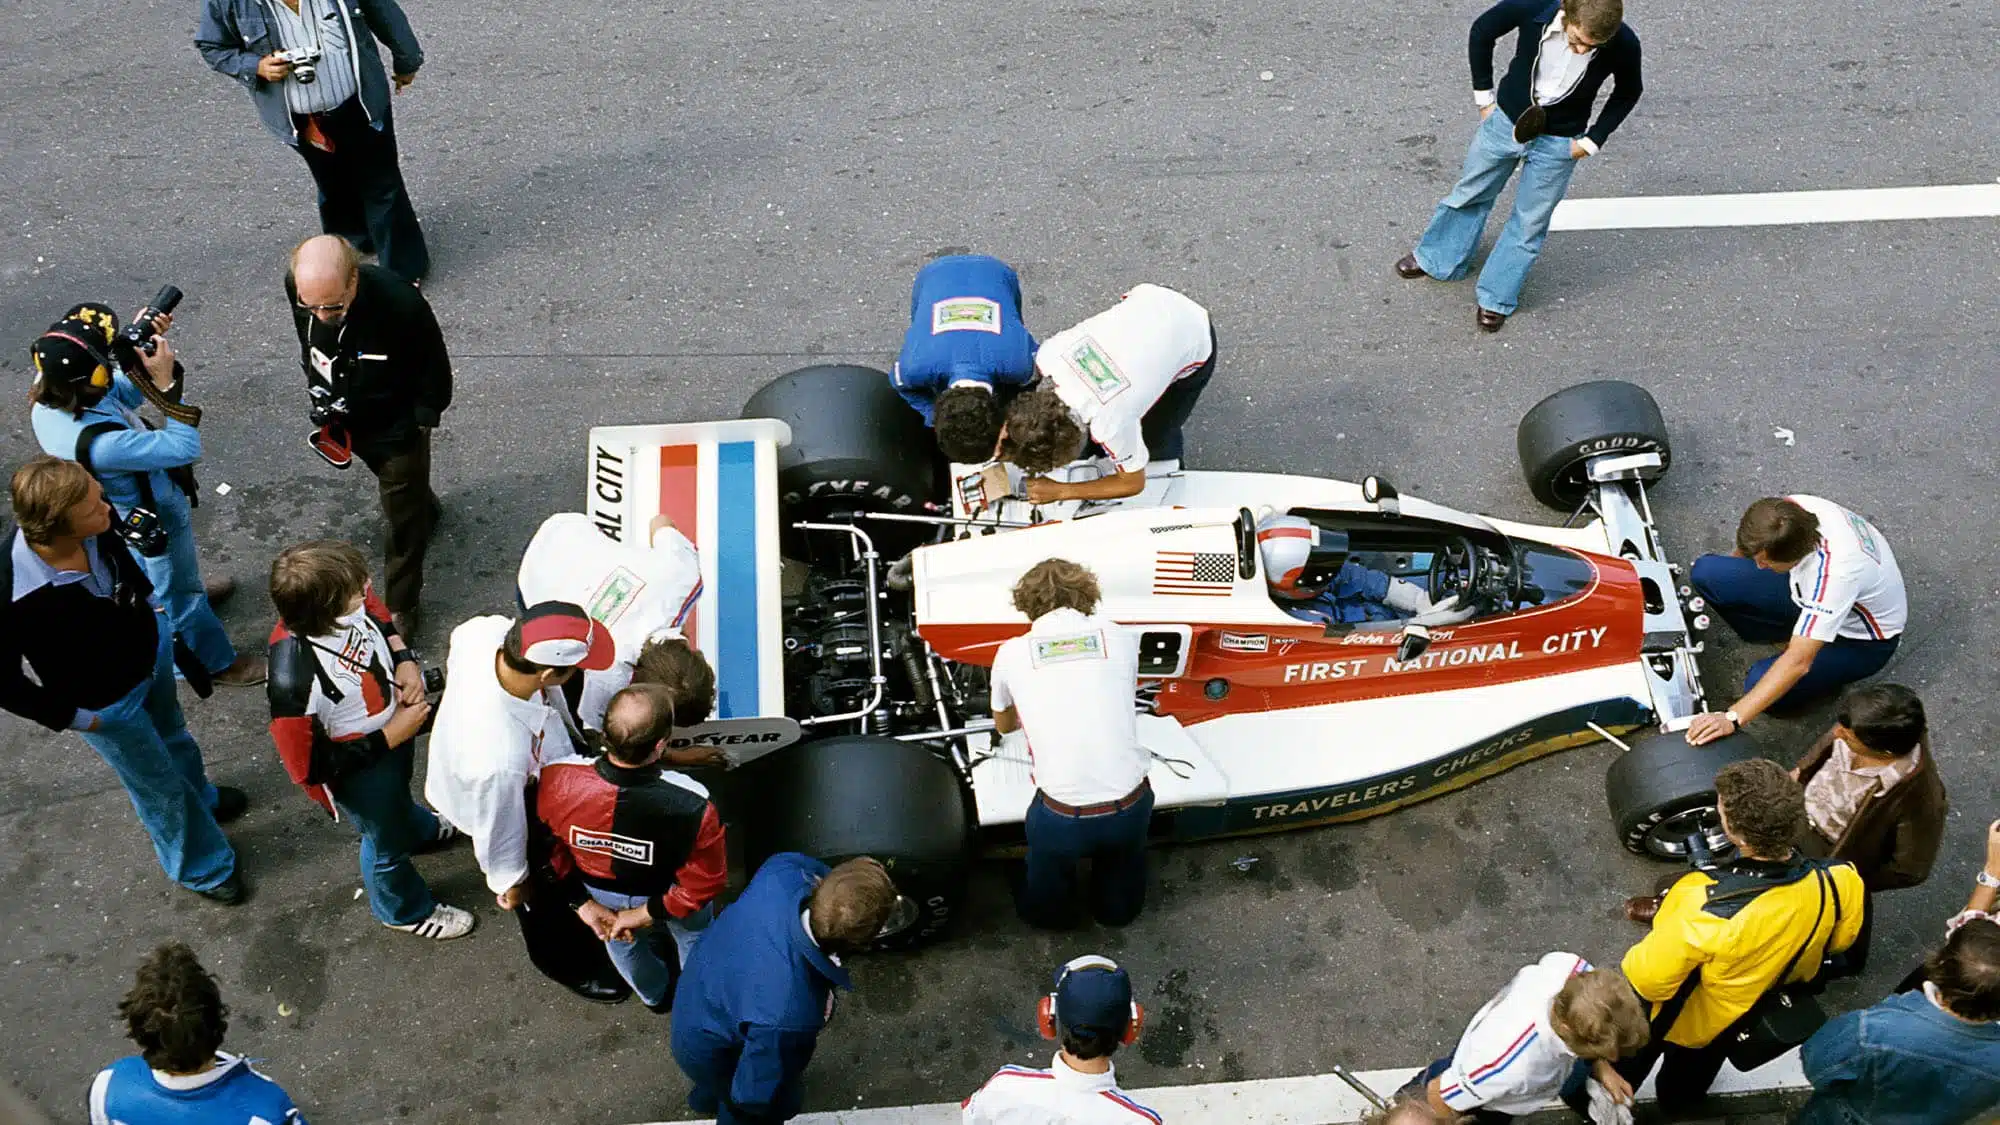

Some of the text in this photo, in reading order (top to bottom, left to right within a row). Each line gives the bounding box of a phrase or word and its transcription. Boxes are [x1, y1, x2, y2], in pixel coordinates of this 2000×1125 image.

[595, 445, 623, 504] CITY
[1223, 636, 1265, 647] CHAMPION
[1284, 626, 1607, 683] FIRST NATIONAL CITY
[1252, 727, 1535, 820] TRAVELERS CHECKS
[579, 839, 643, 857] CHAMPION
